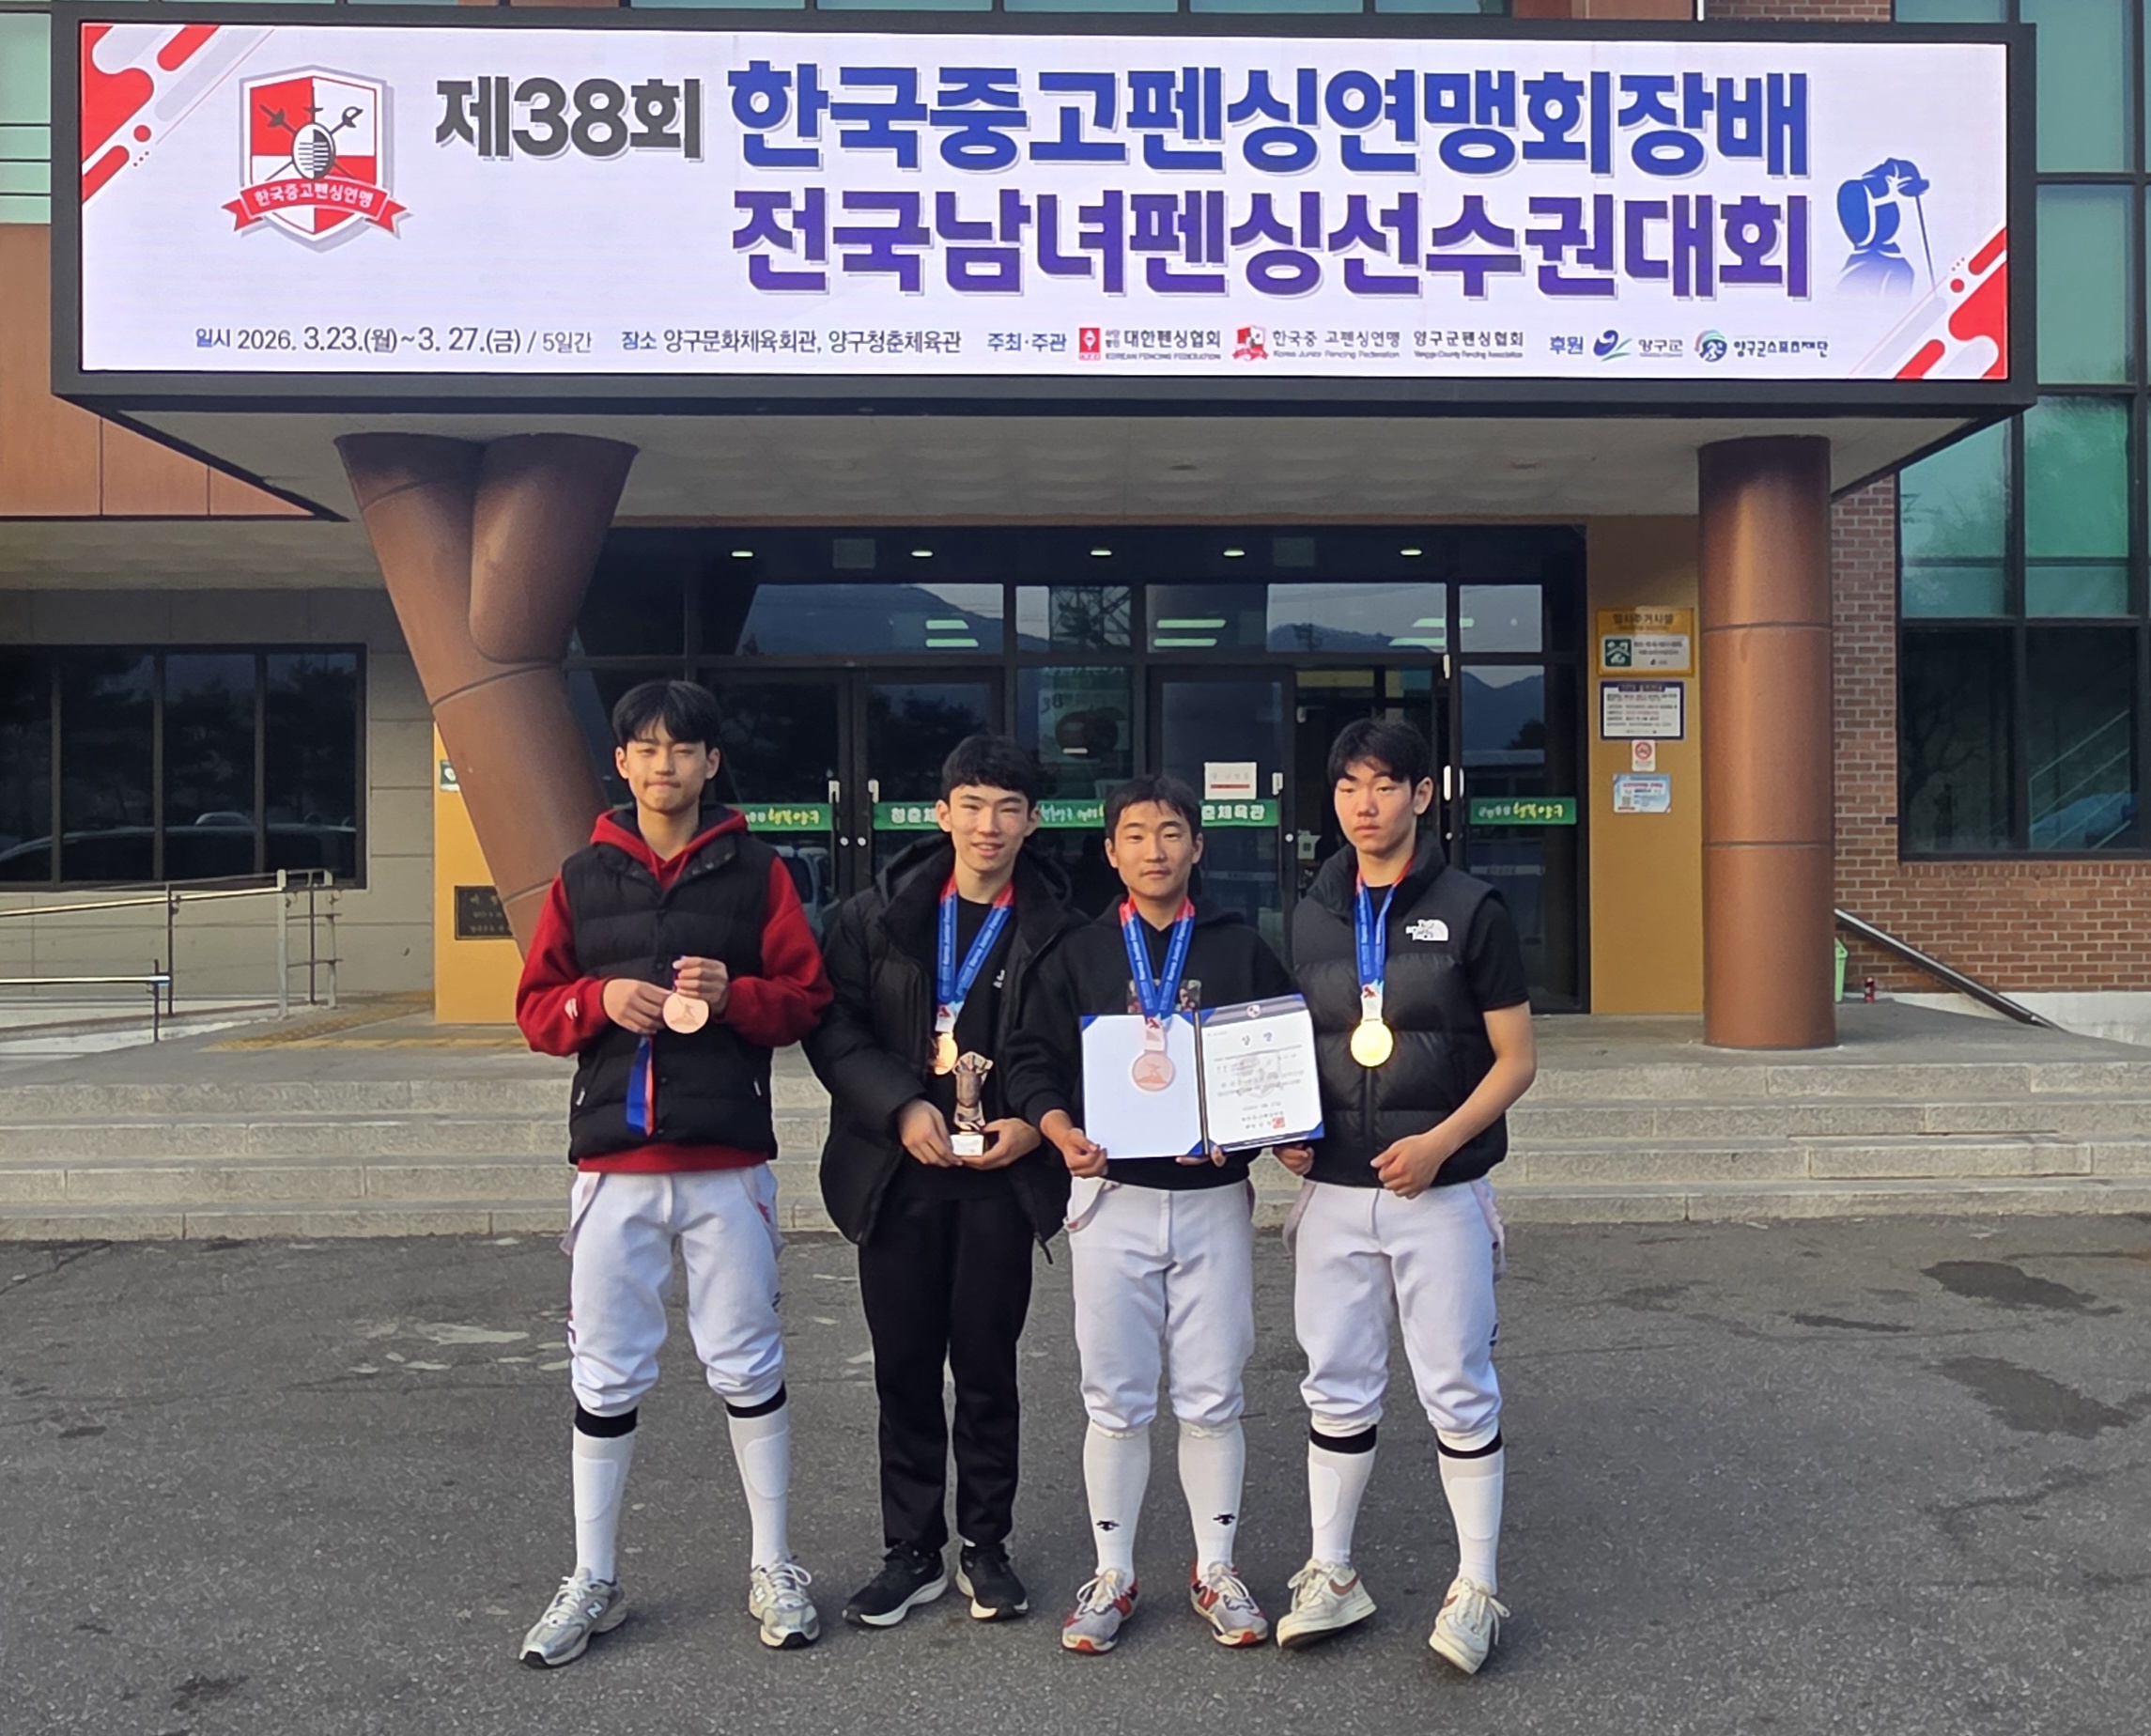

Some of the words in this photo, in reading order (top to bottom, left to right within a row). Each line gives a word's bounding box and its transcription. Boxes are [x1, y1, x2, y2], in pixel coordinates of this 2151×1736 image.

[435, 75, 703, 161] 제38회
[728, 60, 1809, 178] 한국중고펜싱연맹회장배
[254, 182, 374, 209] 한국중고펜싱연맹
[733, 187, 1809, 298] 전국남녀펜싱선수권대회
[195, 328, 231, 348] 일시
[238, 329, 297, 350] 2026.
[542, 331, 593, 353] 5일간
[621, 331, 658, 350] 장소
[663, 329, 822, 353] 양구문화체육회관,
[828, 330, 962, 353] 양구청춘체육관
[1123, 330, 1221, 349] 대한펜싱협회
[1413, 330, 1524, 348] 양구군펜싱협회
[1549, 335, 1584, 355] 후원
[1638, 339, 1683, 352] 양구군
